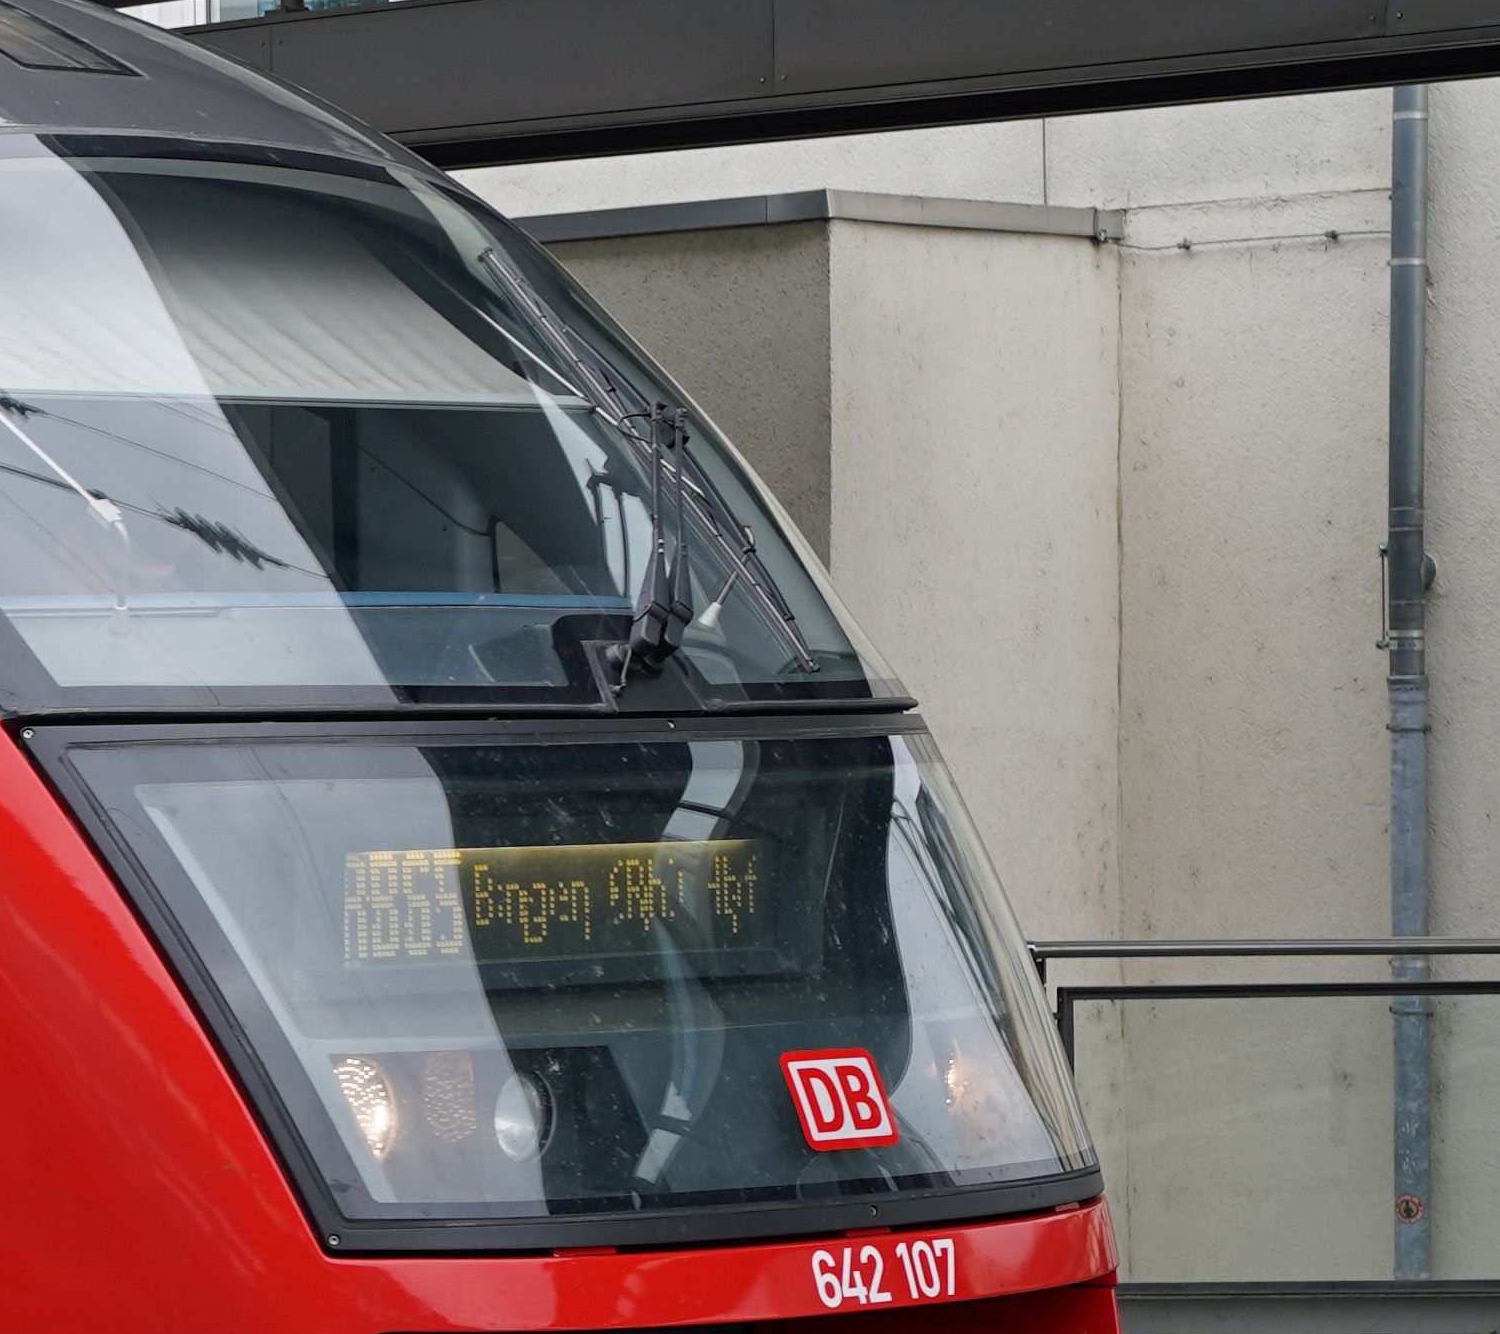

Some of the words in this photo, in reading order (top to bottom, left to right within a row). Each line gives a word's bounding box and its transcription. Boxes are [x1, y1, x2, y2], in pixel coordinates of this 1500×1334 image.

[796, 1065, 882, 1133] DB
[811, 1244, 893, 1309] 642
[895, 1238, 955, 1300] 107
